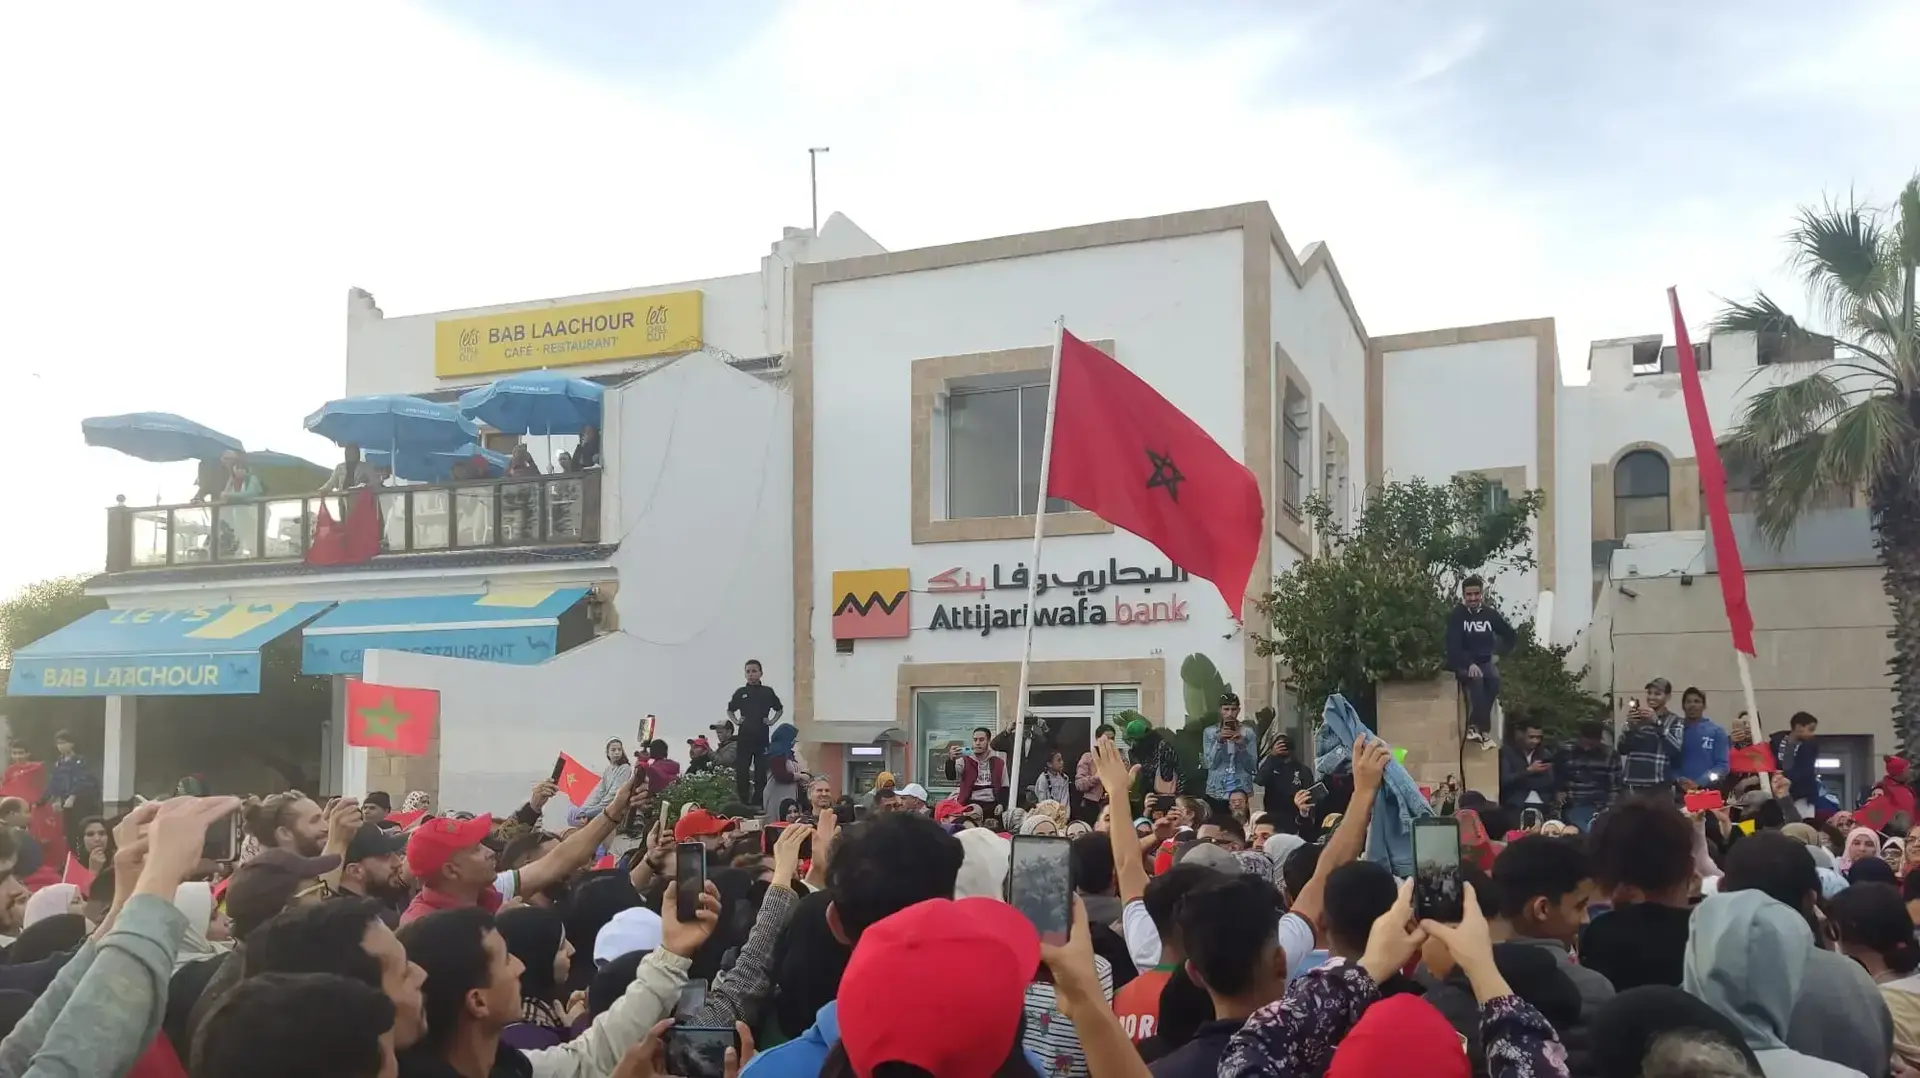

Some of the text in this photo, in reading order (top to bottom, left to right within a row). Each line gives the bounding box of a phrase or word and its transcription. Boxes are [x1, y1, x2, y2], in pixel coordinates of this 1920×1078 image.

[488, 312, 635, 344] BAB LAACHOUR
[504, 343, 534, 359] CAFÉ
[542, 336, 618, 355] RESTAURANT
[993, 562, 1047, 595] وفا
[929, 593, 1188, 636] Attijariwafa bank
[1463, 620, 1492, 633] NASA
[340, 643, 517, 664] CA STAURANT
[43, 664, 219, 687] BAB LAACHOUR
[1119, 1013, 1158, 1040] OR
